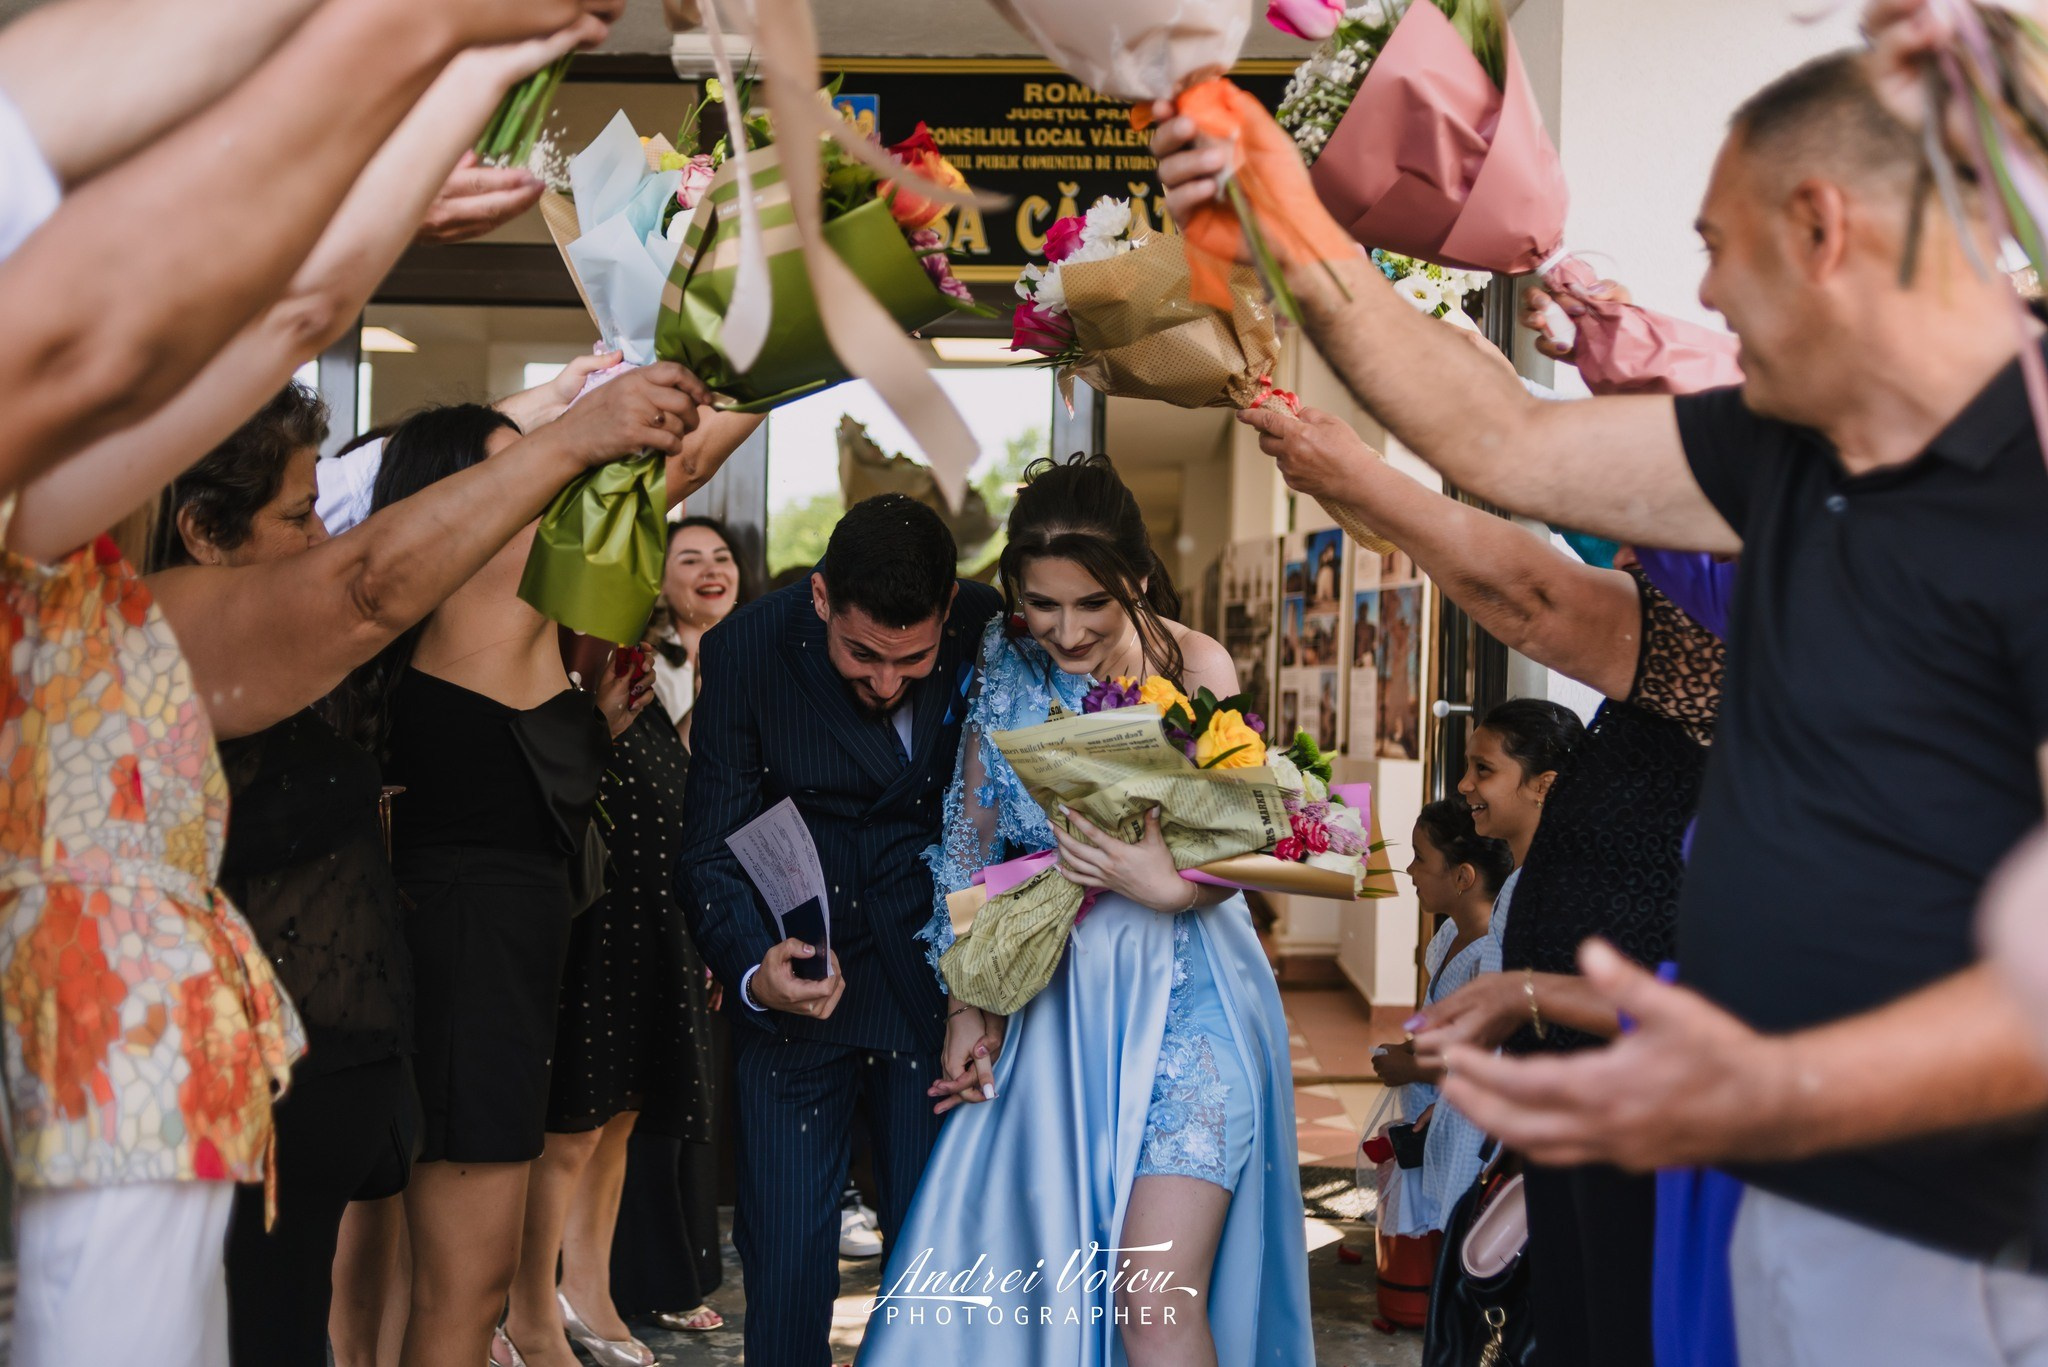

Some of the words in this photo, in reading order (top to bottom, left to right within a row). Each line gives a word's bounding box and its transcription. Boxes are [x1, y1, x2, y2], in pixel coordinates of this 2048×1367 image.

[1095, 108, 1131, 120] PRA
[1025, 127, 1086, 147] LOCAL
[1252, 789, 1272, 827] MARKET
